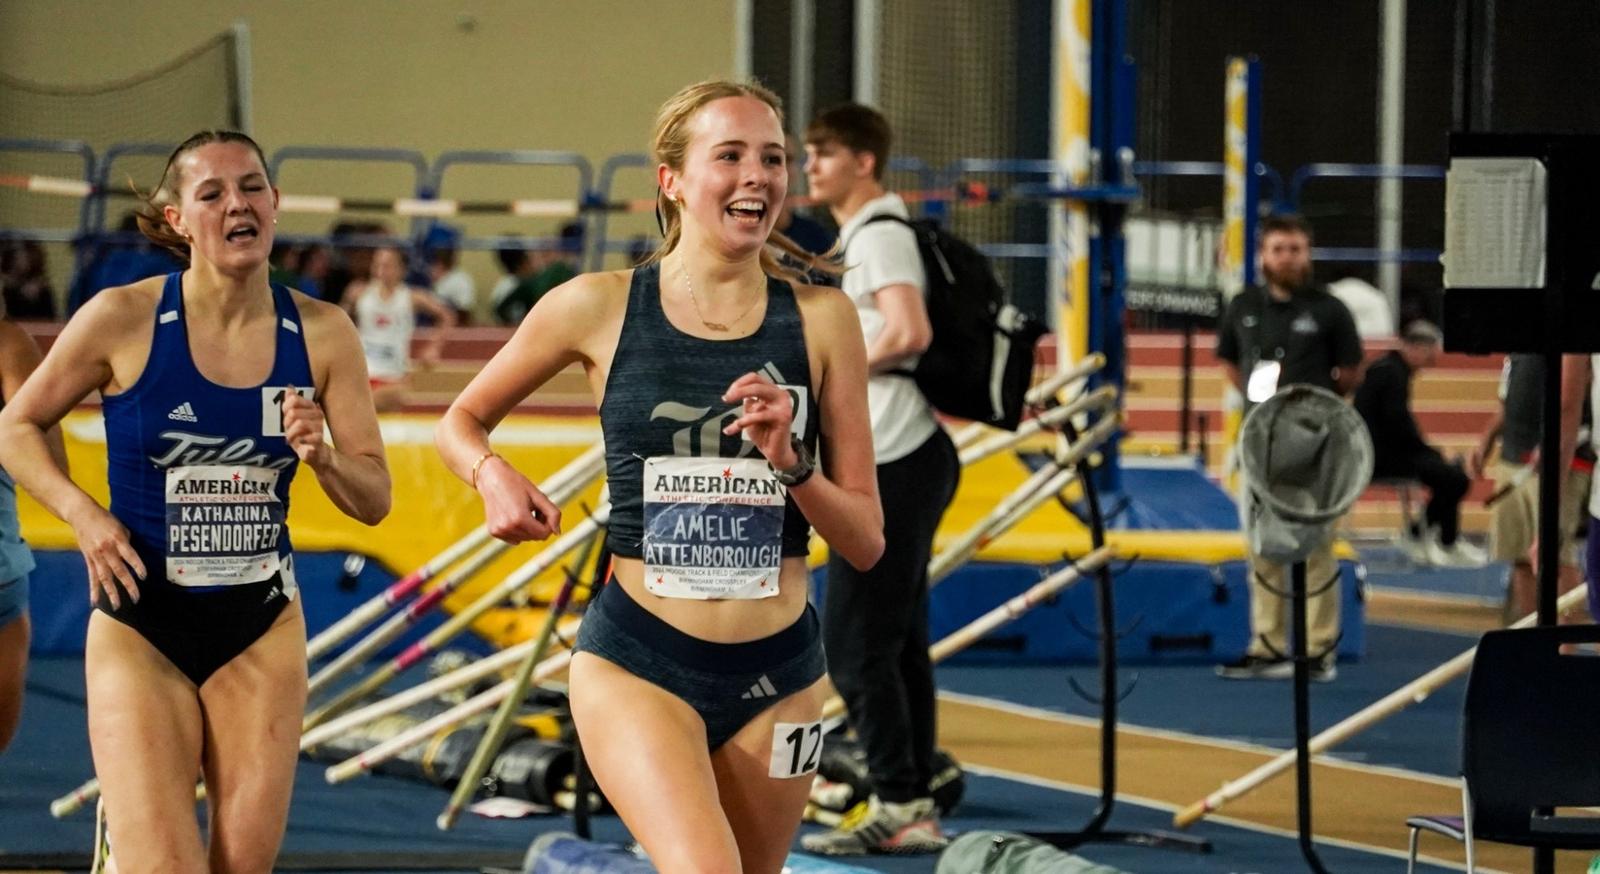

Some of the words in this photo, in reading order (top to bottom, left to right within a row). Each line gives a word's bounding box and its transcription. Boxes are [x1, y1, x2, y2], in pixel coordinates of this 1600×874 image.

[654, 475, 777, 495] AMERICAN
[709, 496, 772, 504] CONFERENCE
[181, 506, 271, 522] KATHARINA
[169, 524, 281, 552] PESENDORFER
[673, 514, 750, 541] AMELIE
[645, 543, 781, 567] ATTENBOROUGH
[786, 724, 821, 775] 12
